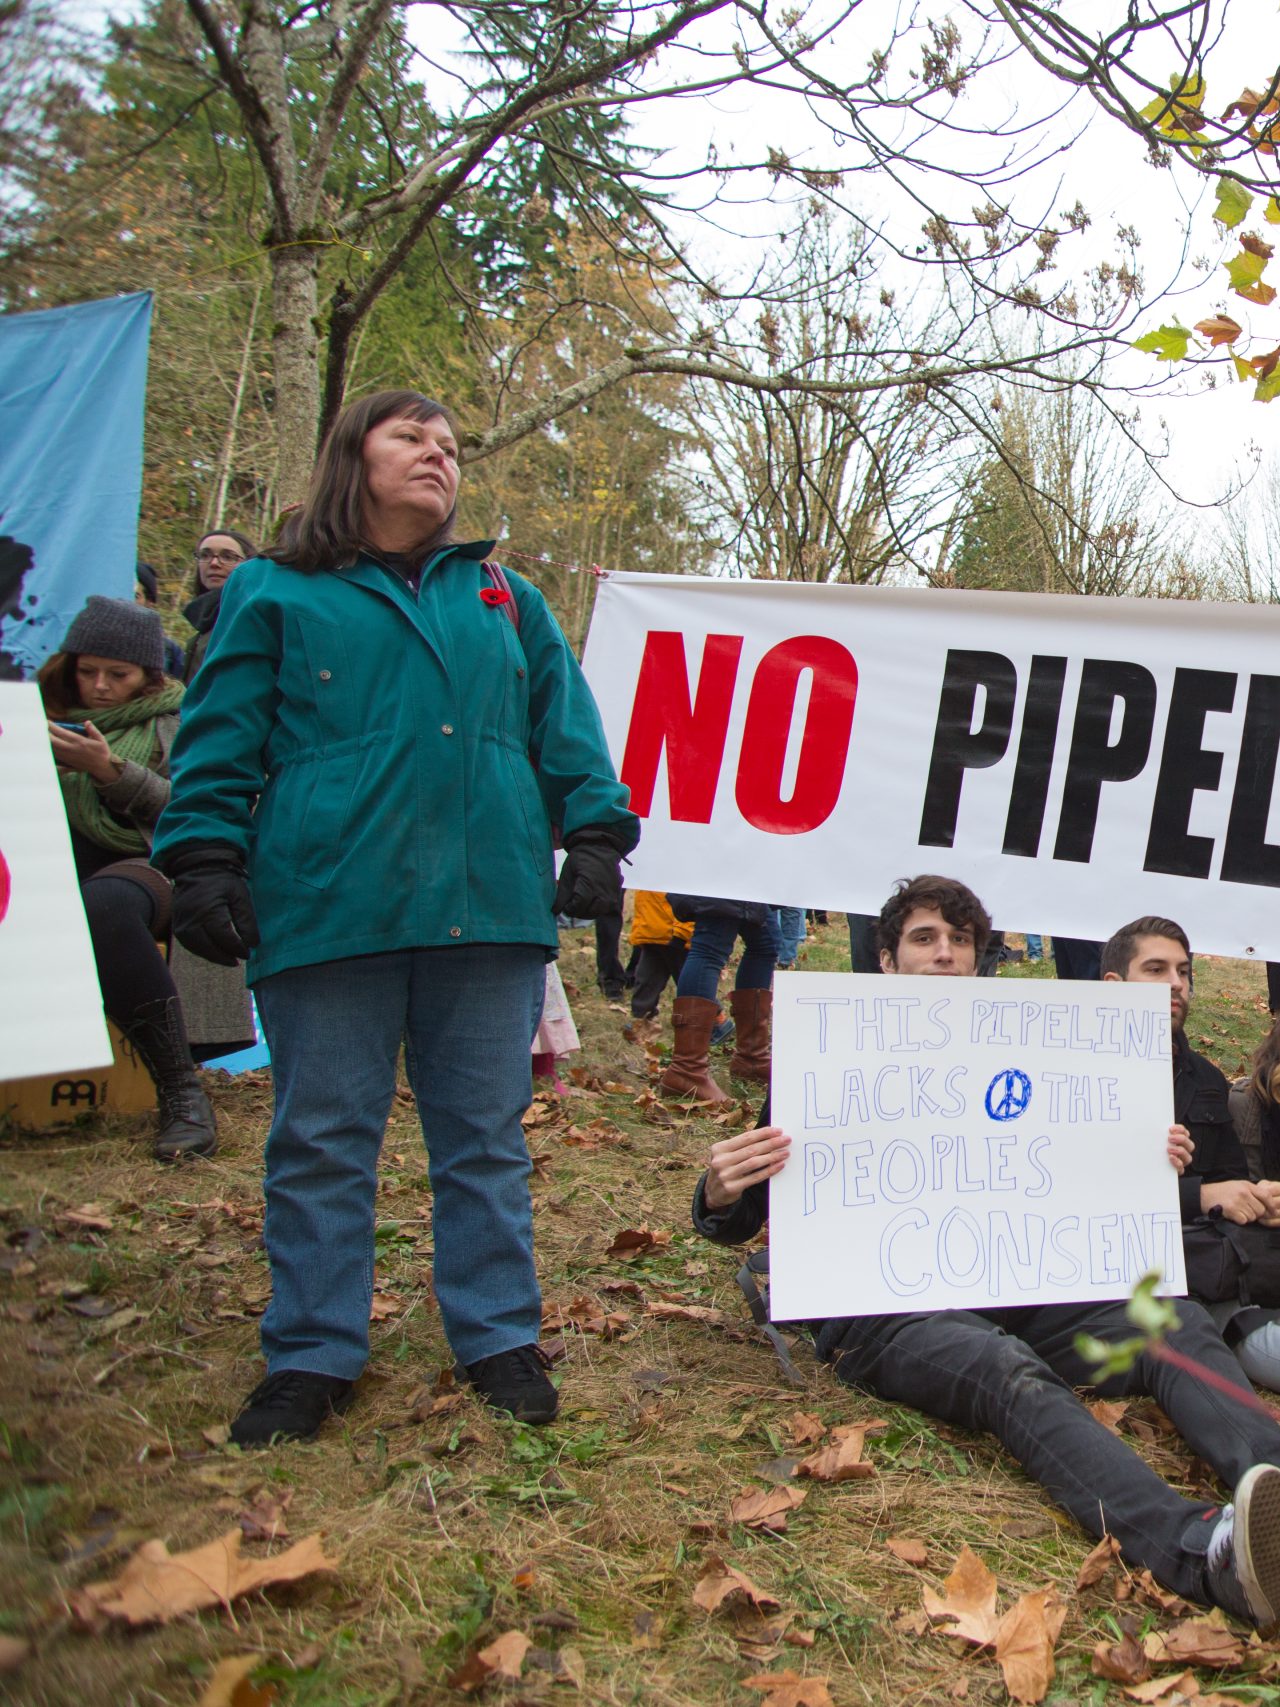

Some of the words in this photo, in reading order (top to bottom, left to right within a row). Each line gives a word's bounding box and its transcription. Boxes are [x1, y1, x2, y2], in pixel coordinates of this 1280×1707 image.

[621, 630, 859, 835] NO
[797, 998, 951, 1053] THIS
[970, 999, 1171, 1062] PIPELINE
[804, 1065, 968, 1129] LACKS
[1041, 1071, 1121, 1123] THE
[803, 1134, 1052, 1216] PEOPLES
[879, 1206, 1180, 1297] CONSENT
